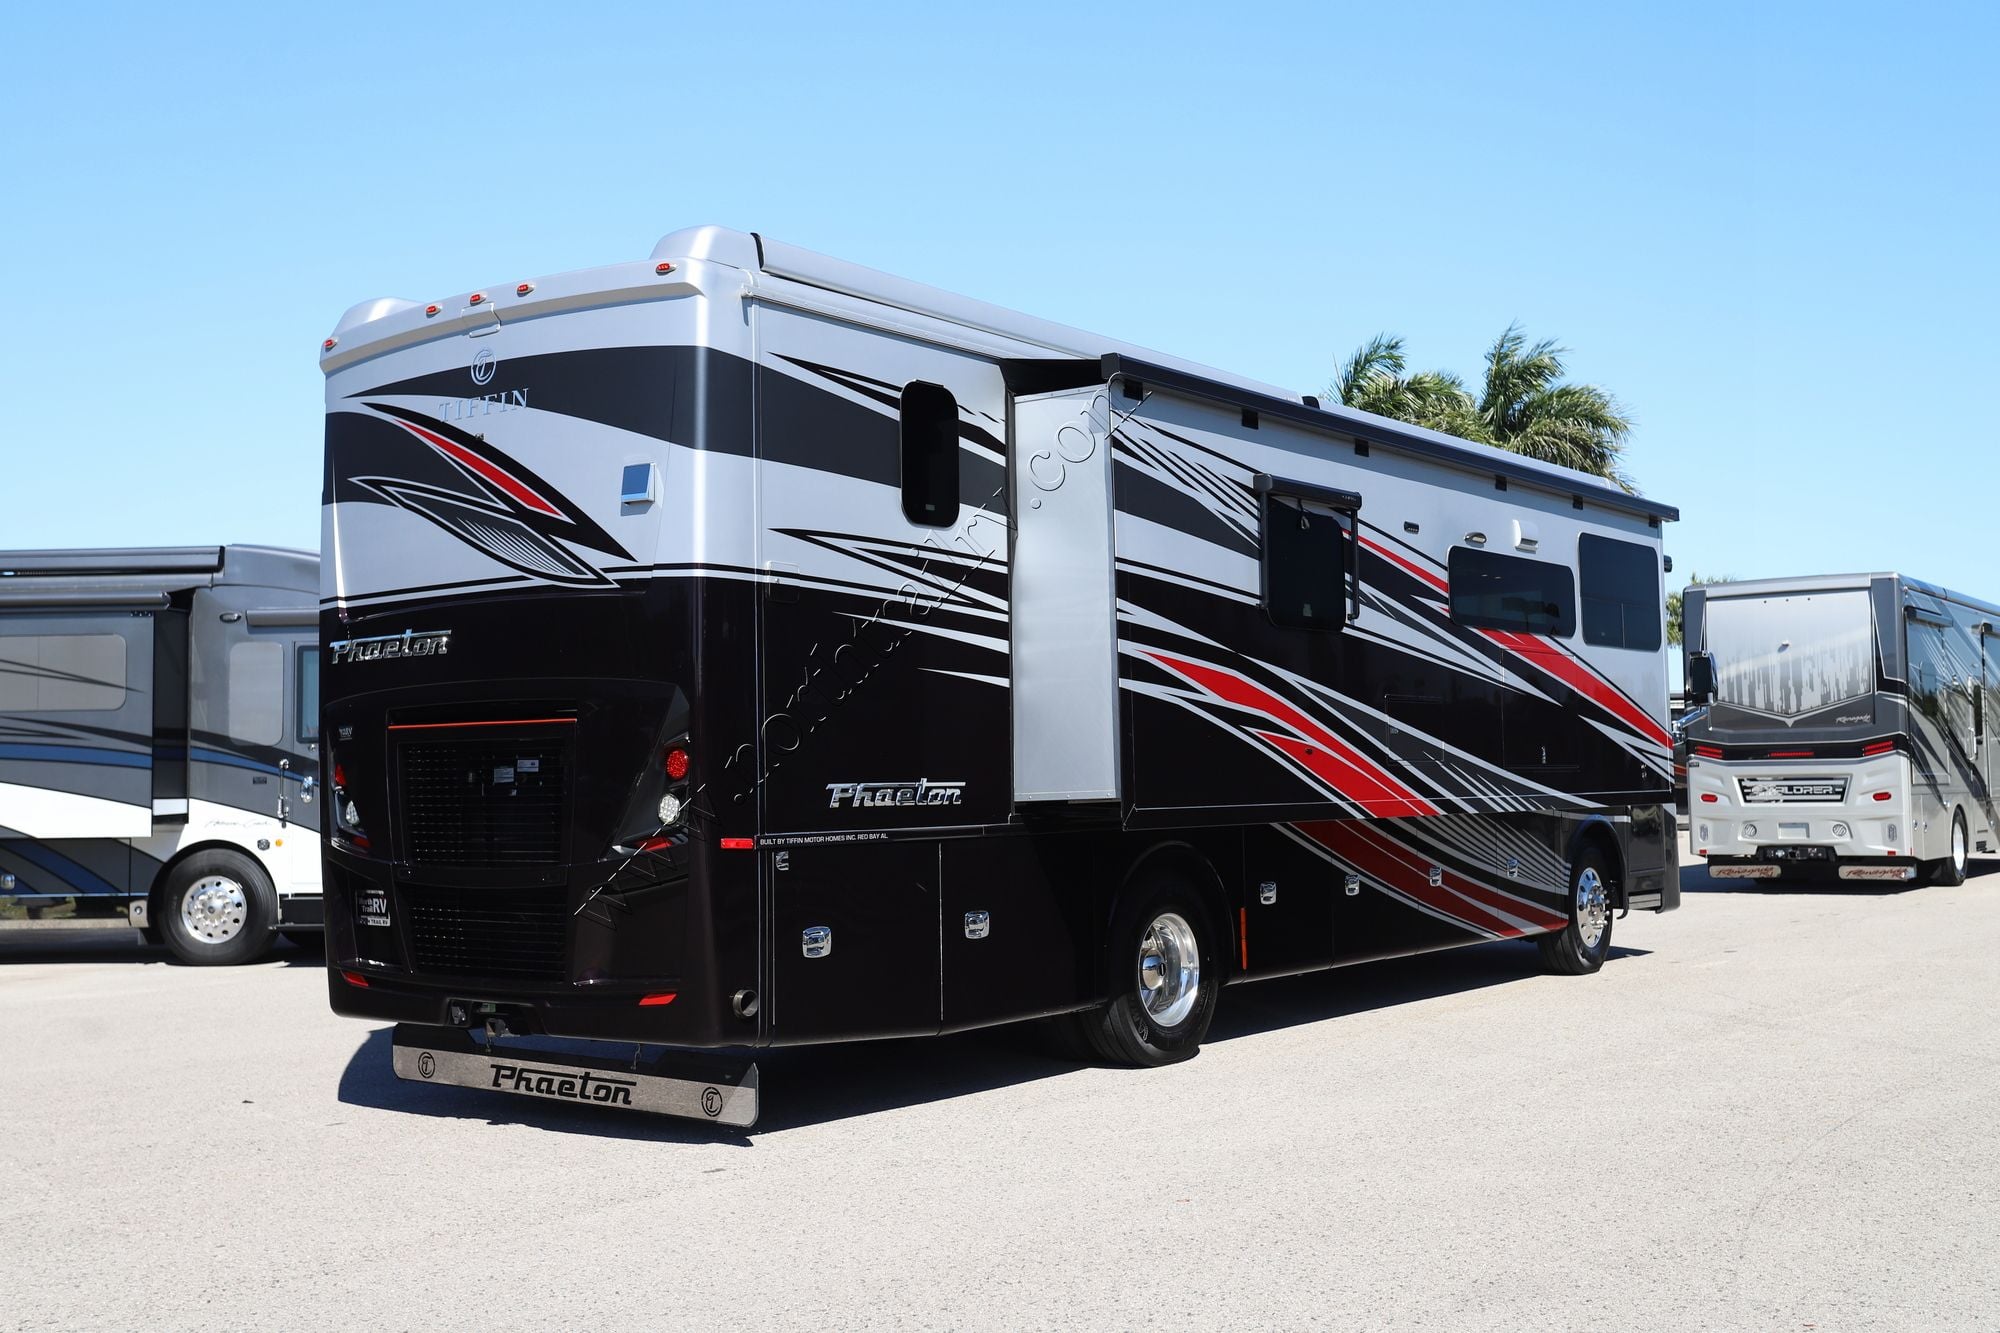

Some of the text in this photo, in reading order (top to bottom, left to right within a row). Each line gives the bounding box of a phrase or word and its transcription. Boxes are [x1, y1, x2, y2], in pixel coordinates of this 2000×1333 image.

[439, 388, 529, 422] TIFFIN
[329, 629, 452, 665] Phaeton
[826, 778, 966, 809] Phaeton
[825, 834, 845, 842] HOMES
[857, 833, 868, 841] RED
[372, 898, 387, 914] RV
[490, 1063, 637, 1105] Phaeton
